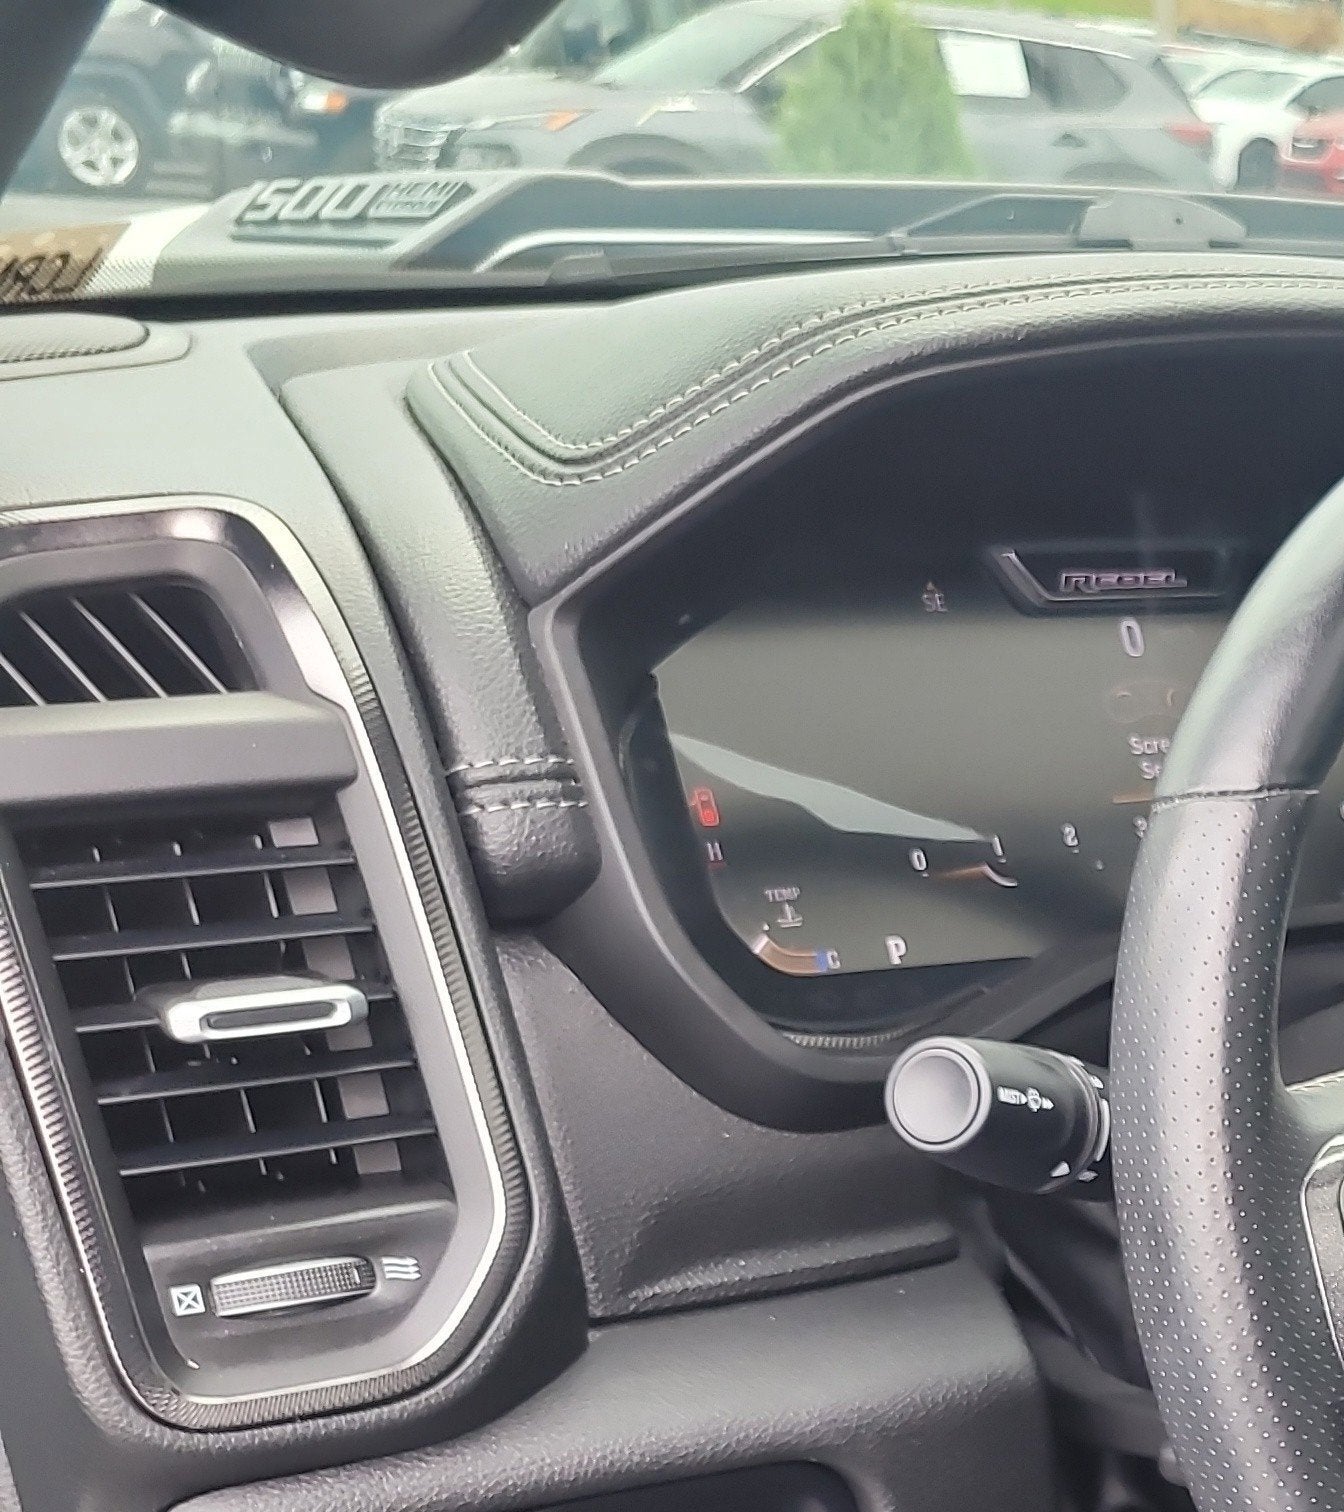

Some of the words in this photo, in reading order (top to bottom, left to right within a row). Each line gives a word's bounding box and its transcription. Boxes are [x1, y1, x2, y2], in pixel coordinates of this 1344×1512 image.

[1119, 617, 1146, 658] 0
[1129, 733, 1169, 755] Scre
[885, 934, 908, 965] P
